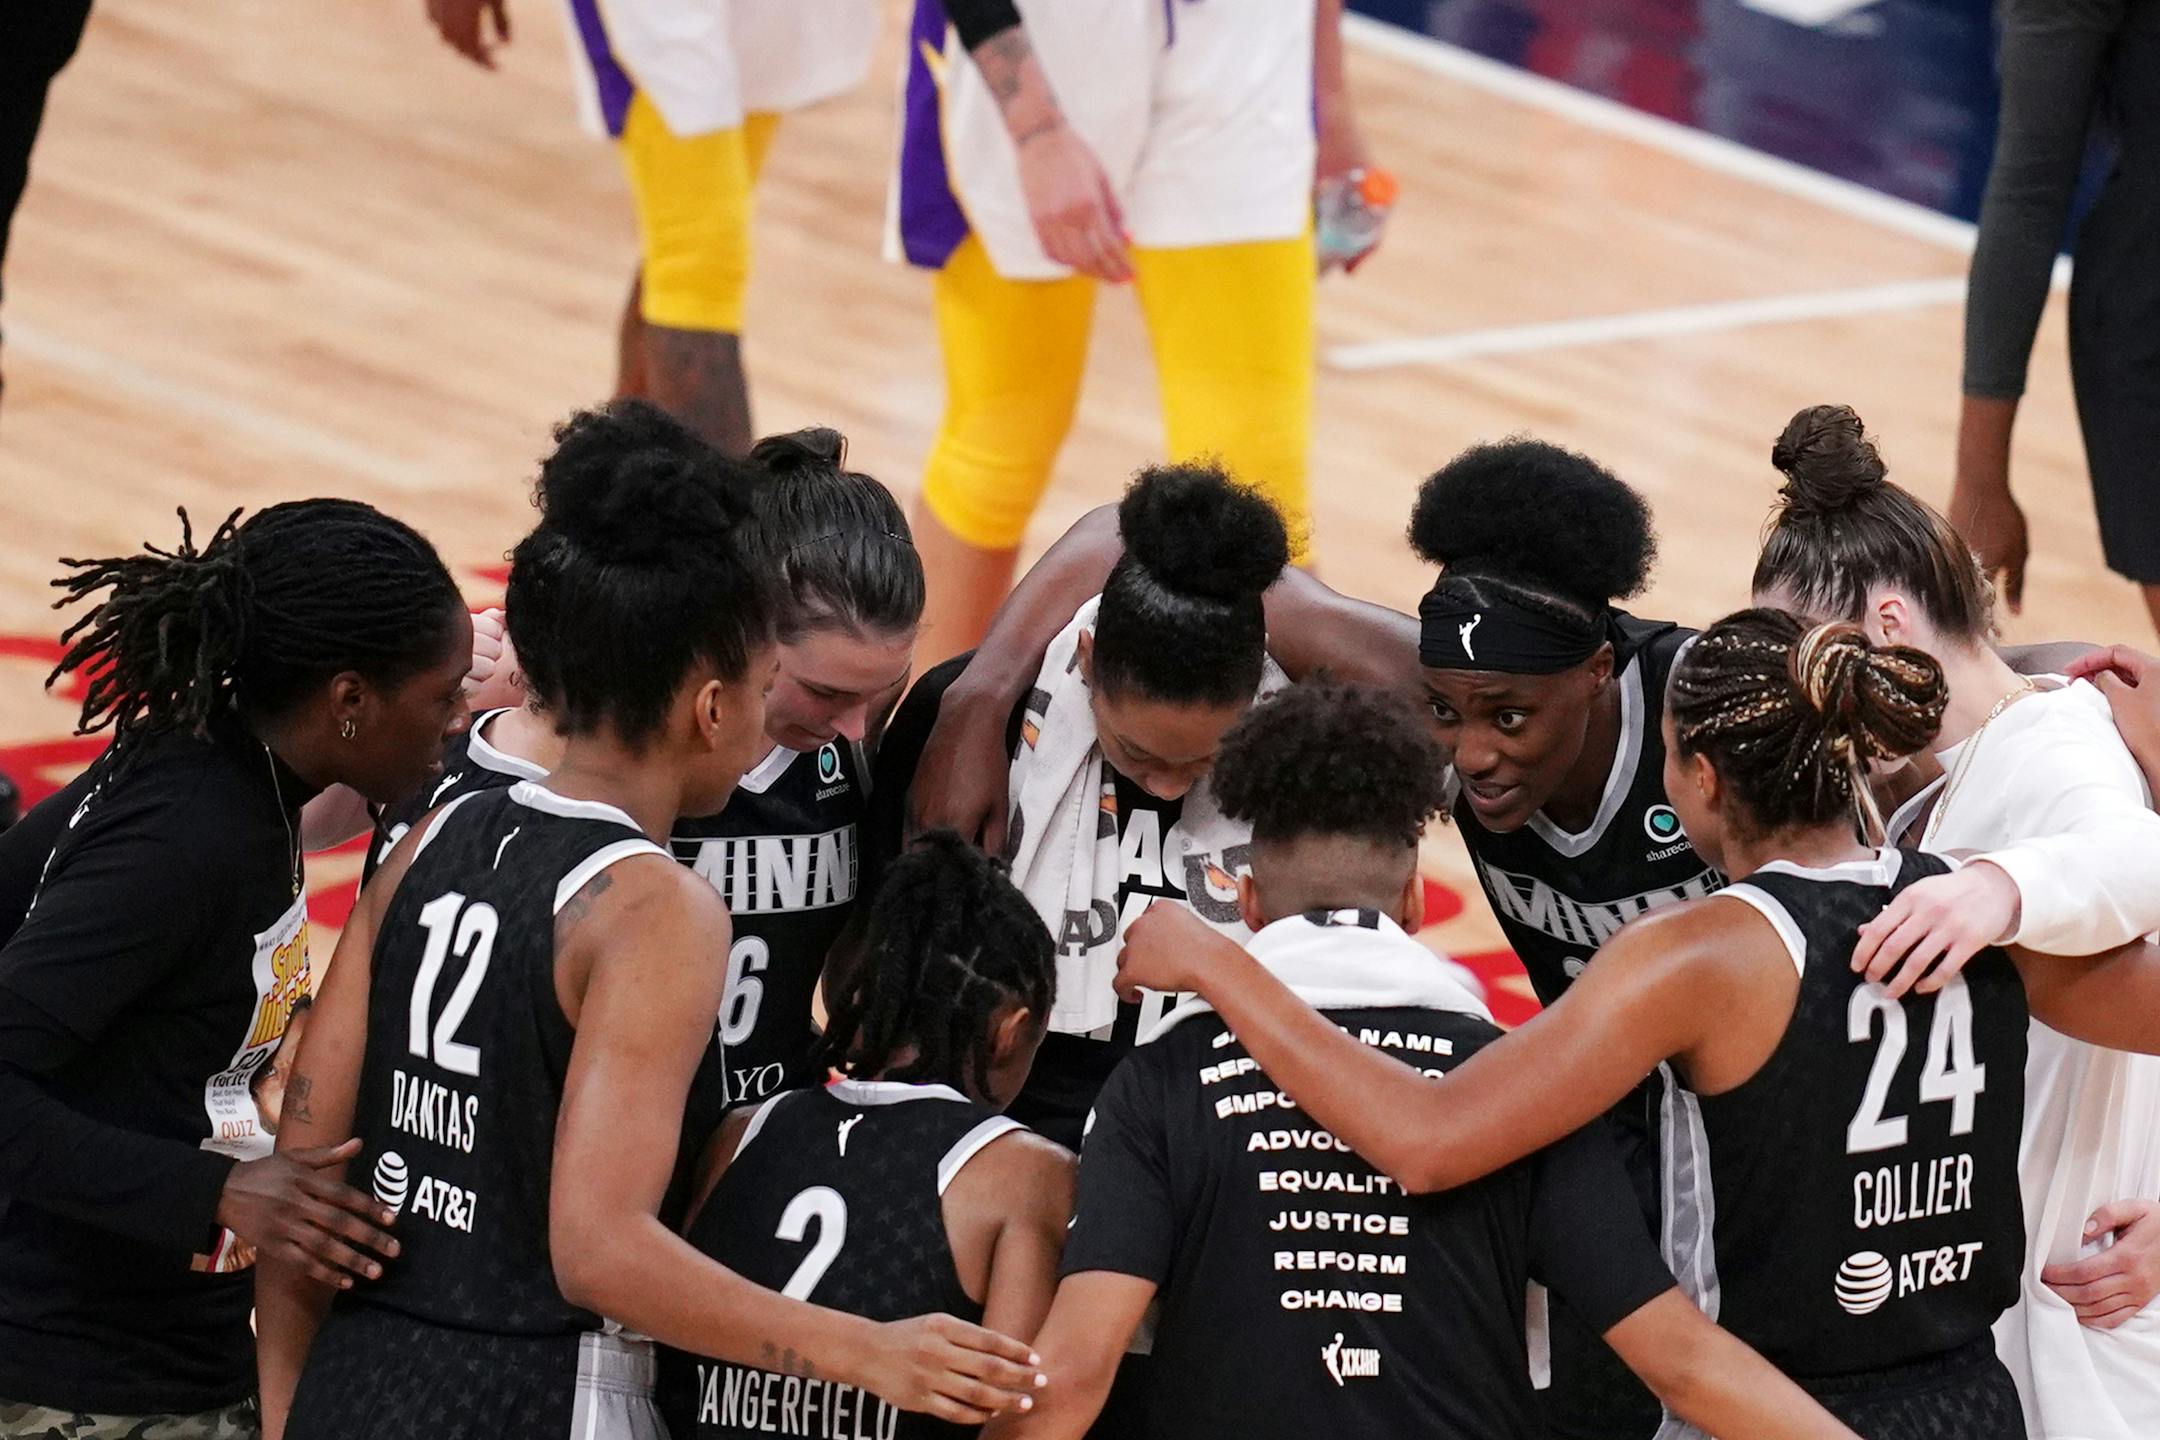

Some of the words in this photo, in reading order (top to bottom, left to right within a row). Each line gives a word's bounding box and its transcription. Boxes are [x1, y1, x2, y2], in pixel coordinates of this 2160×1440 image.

[1646, 841, 1693, 862] shareca
[406, 891, 499, 1077] 12
[718, 936, 769, 1046] 6
[1360, 1028, 1453, 1056] NAME
[1846, 970, 1986, 1155] 24
[221, 1120, 256, 1140] QUIZ
[391, 1069, 479, 1154] DANTAS
[411, 1175, 477, 1233] AT&T
[1853, 1152, 1974, 1229] COLLIER
[774, 1184, 848, 1301] 2
[1268, 1210, 1410, 1236] JUSTICE
[1273, 1250, 1407, 1275] REFORM
[1898, 1241, 1984, 1299] AT&T
[1279, 1289, 1403, 1313] CHANGE
